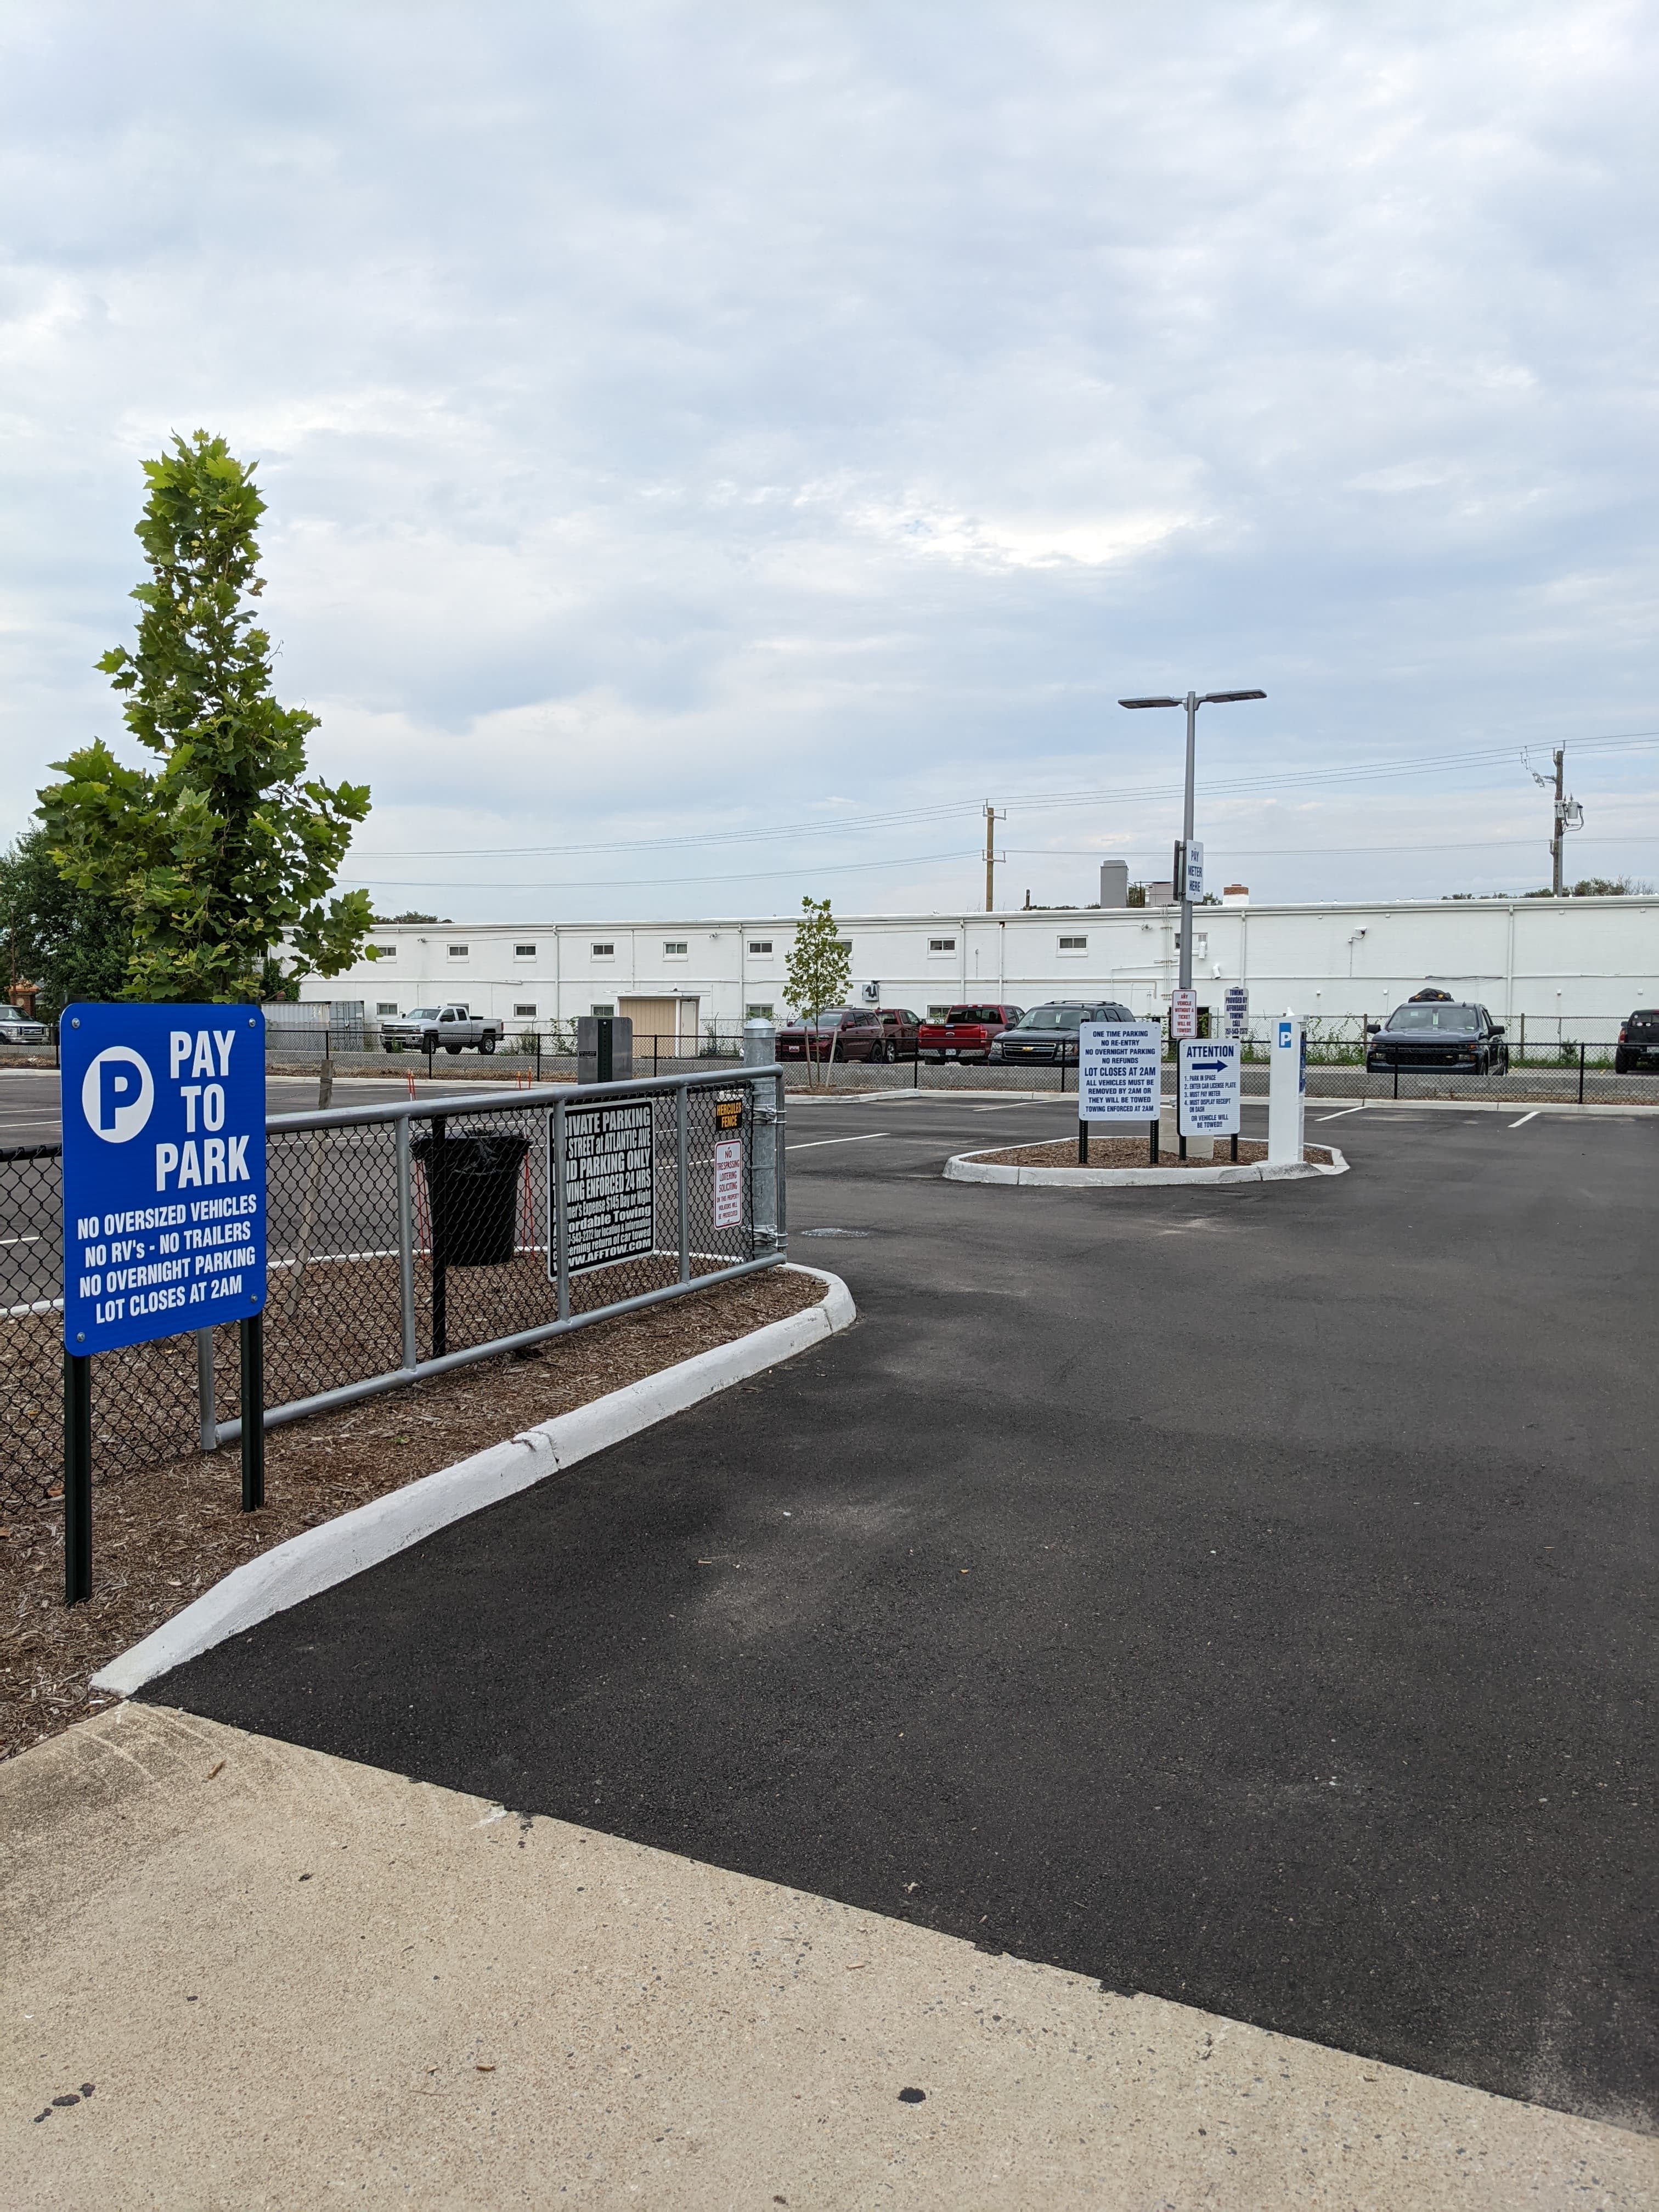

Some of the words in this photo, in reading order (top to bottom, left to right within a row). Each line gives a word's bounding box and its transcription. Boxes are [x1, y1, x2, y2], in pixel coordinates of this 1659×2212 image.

[1188, 865, 1203, 878] METER
[1190, 850, 1199, 862] PAY
[1189, 880, 1200, 892] HERE
[1186, 1046, 1234, 1058] ATTENTION
[1281, 1031, 1291, 1046] P
[170, 1030, 236, 1079] PAY
[1085, 1067, 1098, 1076] LOT
[1099, 1067, 1126, 1076] CLOSES
[1128, 1067, 1138, 1076] AT
[1139, 1067, 1156, 1076] 2AM
[99, 1060, 143, 1131] P
[180, 1084, 225, 1133] TO
[716, 1102, 742, 1116] HERCULES
[552, 1113, 600, 1139] IVATE
[602, 1107, 651, 1132] PARKING
[721, 1114, 737, 1128] FENCE
[568, 1135, 595, 1159] STREET
[596, 1135, 603, 1155] at
[604, 1128, 637, 1153] ATLANTIC
[638, 1127, 651, 1148] AVE
[725, 1150, 732, 1159] NO
[156, 1135, 251, 1192] PARK
[579, 1152, 625, 1179] PARKING
[627, 1148, 651, 1171] ONLY
[717, 1160, 740, 1171] TRESPASSING
[719, 1171, 737, 1182] LOITERING
[586, 1173, 624, 1199] ENFORCED
[625, 1171, 635, 1192] 24
[636, 1168, 651, 1189] HRS
[719, 1181, 737, 1193] SOLICITING
[77, 1216, 99, 1240] NO
[104, 1204, 186, 1235] OVERSIZED
[190, 1194, 257, 1222] VEHICLES
[566, 1202, 582, 1220] ner's
[583, 1199, 606, 1216] Expense
[606, 1194, 619, 1212] $145
[619, 1193, 630, 1208] Day
[631, 1194, 636, 1206] or
[637, 1189, 651, 1206] Night
[552, 1212, 611, 1237] ordable
[613, 1205, 651, 1223] Towing
[567, 1229, 594, 1245] 7-543-2372
[601, 1223, 620, 1237] location
[620, 1223, 624, 1232] &
[625, 1217, 651, 1232] information
[85, 1244, 106, 1268] NO
[111, 1239, 145, 1263] RV's
[160, 1232, 179, 1255] NO
[183, 1221, 251, 1250] TRAILERS
[552, 1242, 591, 1260] cerning
[591, 1237, 612, 1250] return
[613, 1233, 620, 1245] of
[620, 1233, 631, 1243] car
[631, 1227, 651, 1239] towed
[553, 1238, 651, 1272] W.AFFTOW.COM
[80, 1274, 101, 1299] NO
[106, 1258, 190, 1293] OVERNIGHT
[195, 1246, 255, 1276] PARKING
[96, 1298, 125, 1324] LOT
[129, 1286, 185, 1317] CLOSES
[189, 1282, 207, 1304] AT
[211, 1274, 242, 1300] 2AM
